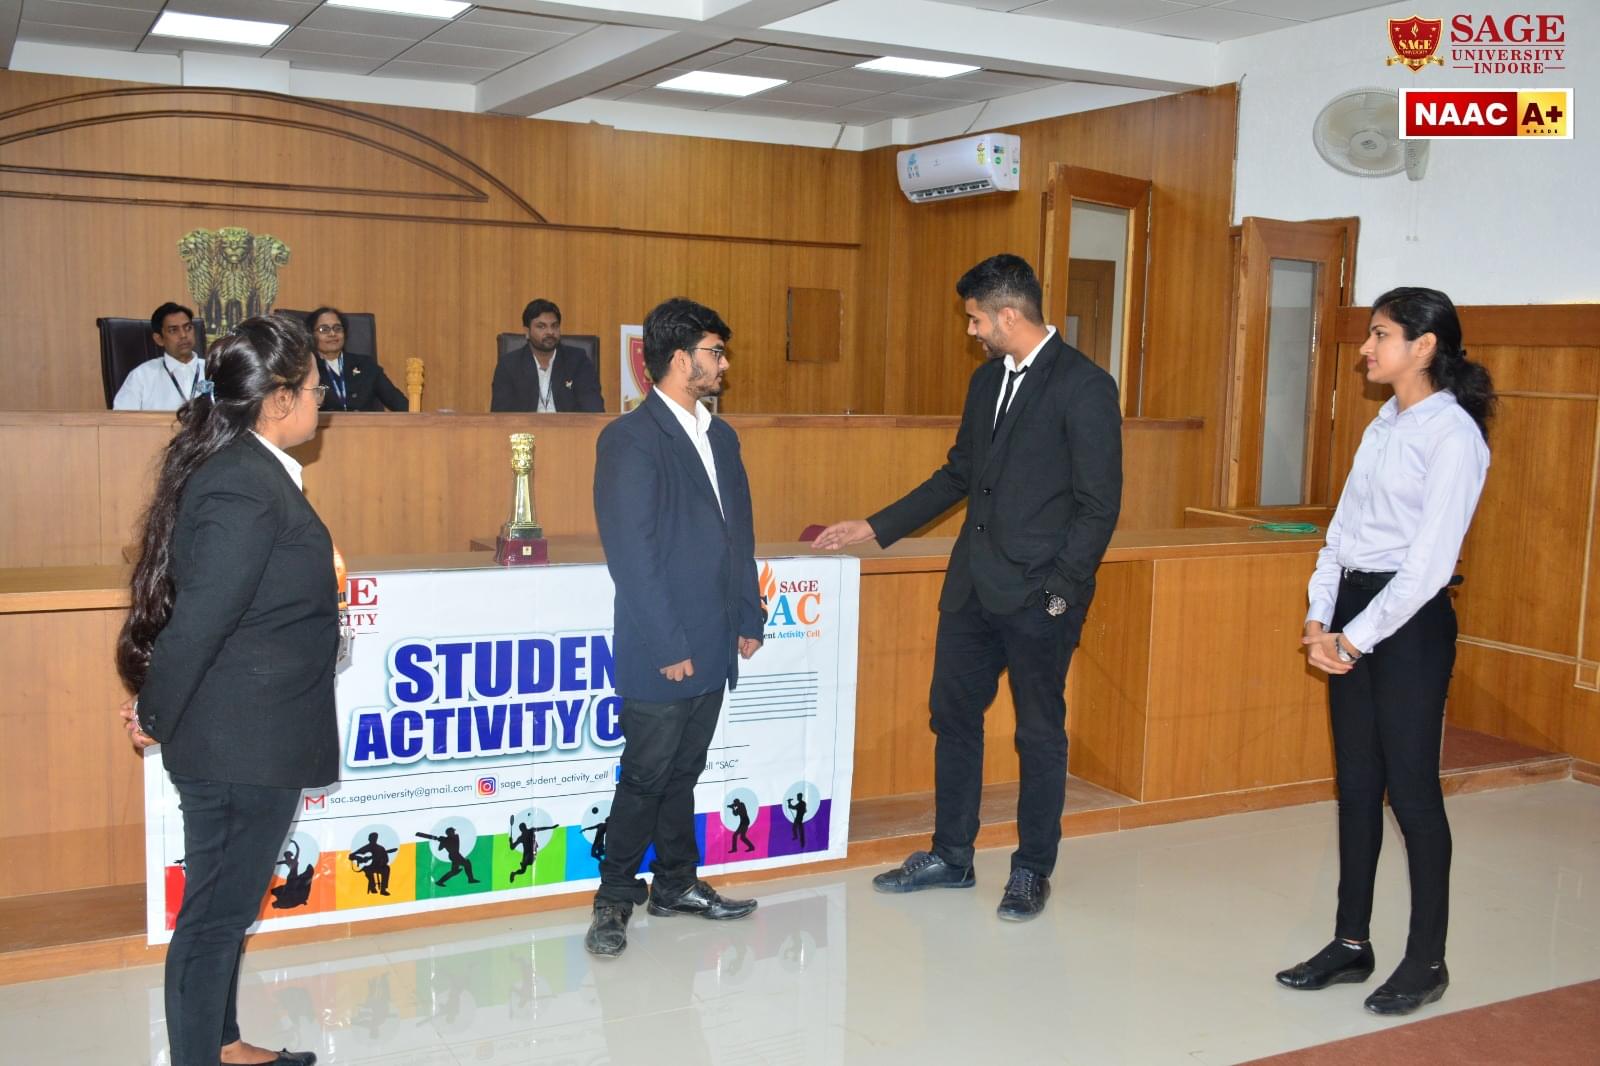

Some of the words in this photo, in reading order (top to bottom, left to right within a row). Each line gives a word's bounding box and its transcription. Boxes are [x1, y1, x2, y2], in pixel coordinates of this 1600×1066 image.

[780, 579, 819, 593] SAGE
[778, 629, 805, 639] Activity
[394, 635, 615, 703] STUDEN
[353, 698, 586, 762] ACTIVITY
[500, 770, 609, 789] sage_student_activity_cell
[330, 784, 473, 805] sac.sageuniversity@gmail.com
